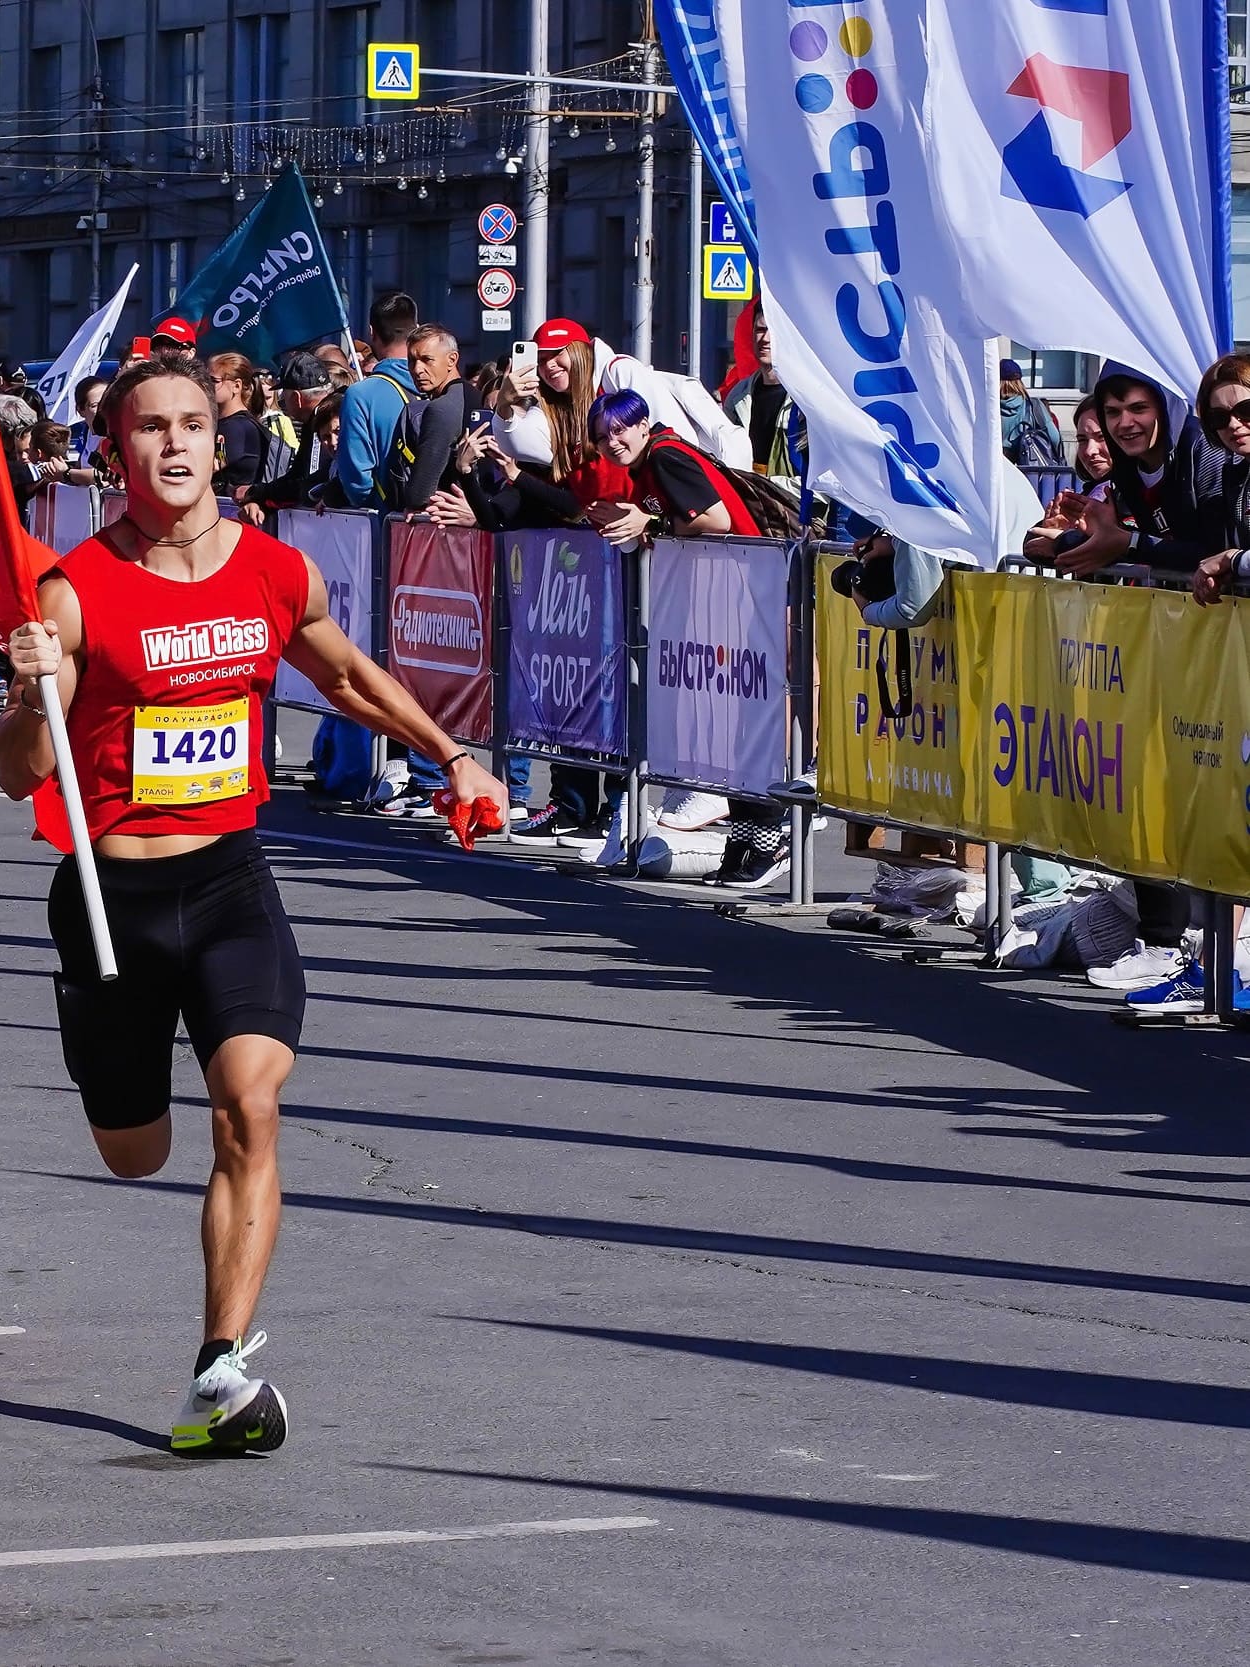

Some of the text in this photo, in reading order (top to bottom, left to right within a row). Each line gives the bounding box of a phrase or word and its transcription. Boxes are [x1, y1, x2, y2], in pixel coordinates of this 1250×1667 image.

[325, 580, 351, 637] СБ
[147, 622, 266, 666] World Class
[1060, 638, 1125, 693] ГРУППА
[169, 662, 256, 687] НОВОСИБИРСК
[529, 653, 591, 708] SPORT
[151, 725, 237, 764] 1420
[993, 702, 1124, 814] ЭТАЛОН
[138, 788, 174, 796] ЭТАЛОН
